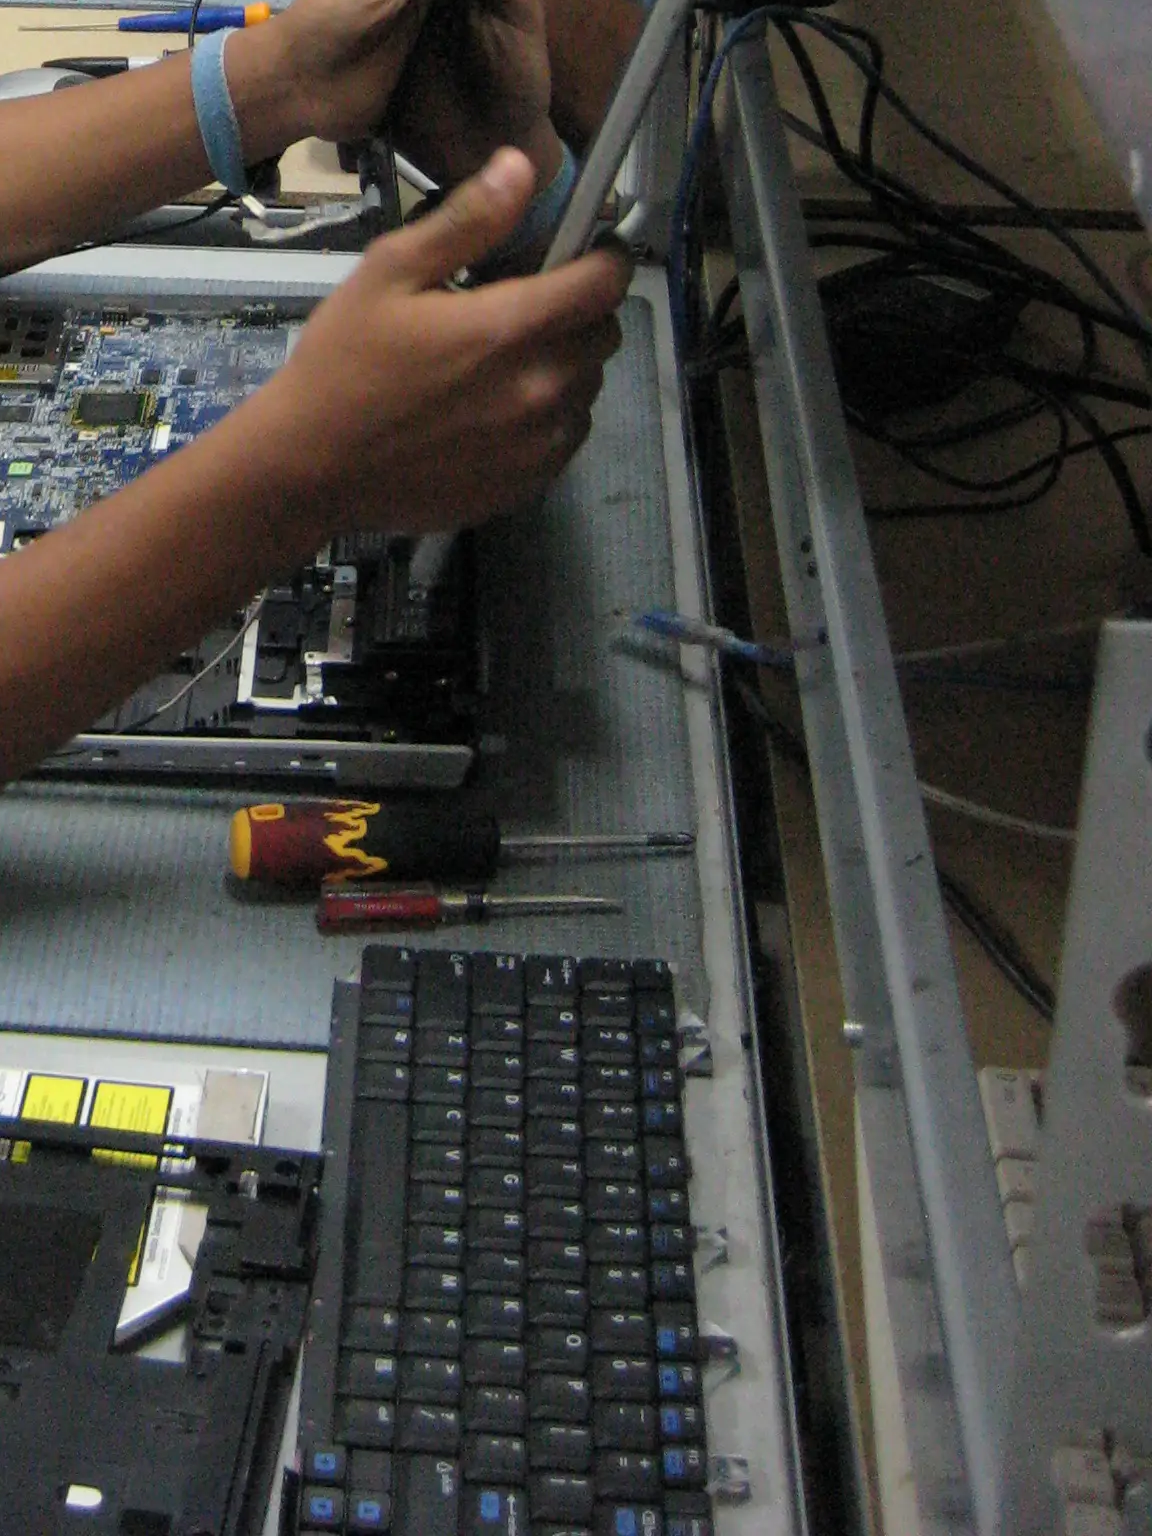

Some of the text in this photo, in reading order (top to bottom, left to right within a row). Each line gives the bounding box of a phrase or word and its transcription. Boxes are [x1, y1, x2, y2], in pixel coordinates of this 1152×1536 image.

[560, 1012, 573, 1022] Q
[505, 1022, 518, 1030] A
[561, 1049, 574, 1061] W
[505, 1057, 518, 1065] S
[505, 1095, 519, 1104] D
[562, 1123, 575, 1131] R
[442, 1036, 462, 1287] Z X C V B N M
[563, 1161, 577, 1172] T
[504, 1174, 519, 1184] G
[564, 1205, 578, 1215] Y
[504, 1215, 518, 1225] H
[564, 1247, 579, 1256] U
[609, 1270, 622, 1278] 8
[504, 1301, 519, 1311] K
[566, 1335, 581, 1347] O
[613, 1360, 627, 1369] 0
[568, 1381, 583, 1390] P
